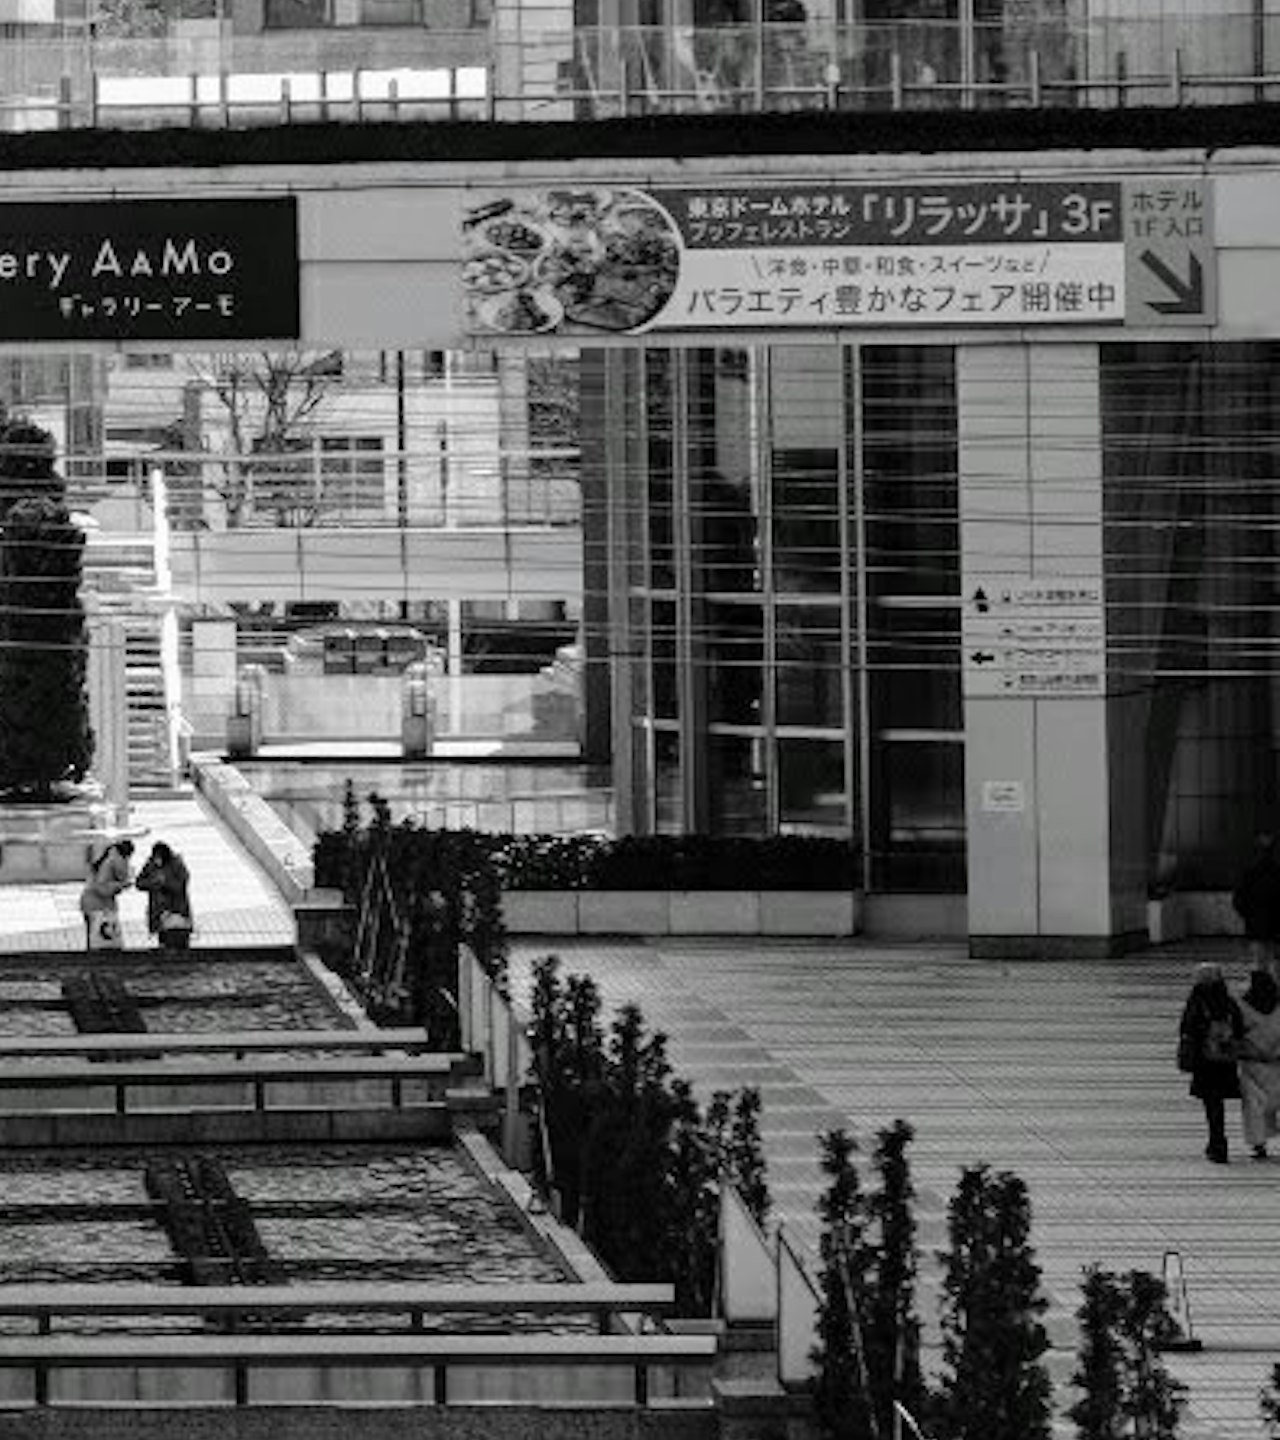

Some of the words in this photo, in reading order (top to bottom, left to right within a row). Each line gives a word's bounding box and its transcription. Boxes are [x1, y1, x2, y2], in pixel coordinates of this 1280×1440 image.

[689, 195, 852, 219] 東京ドームホテル
[1061, 193, 1114, 233] 3F
[1131, 189, 1203, 212] ホテル
[58, 293, 162, 319] ギャラリー
[173, 294, 233, 317] アーモ
[689, 283, 1116, 315] バラエティ豊かなフェア開催中
